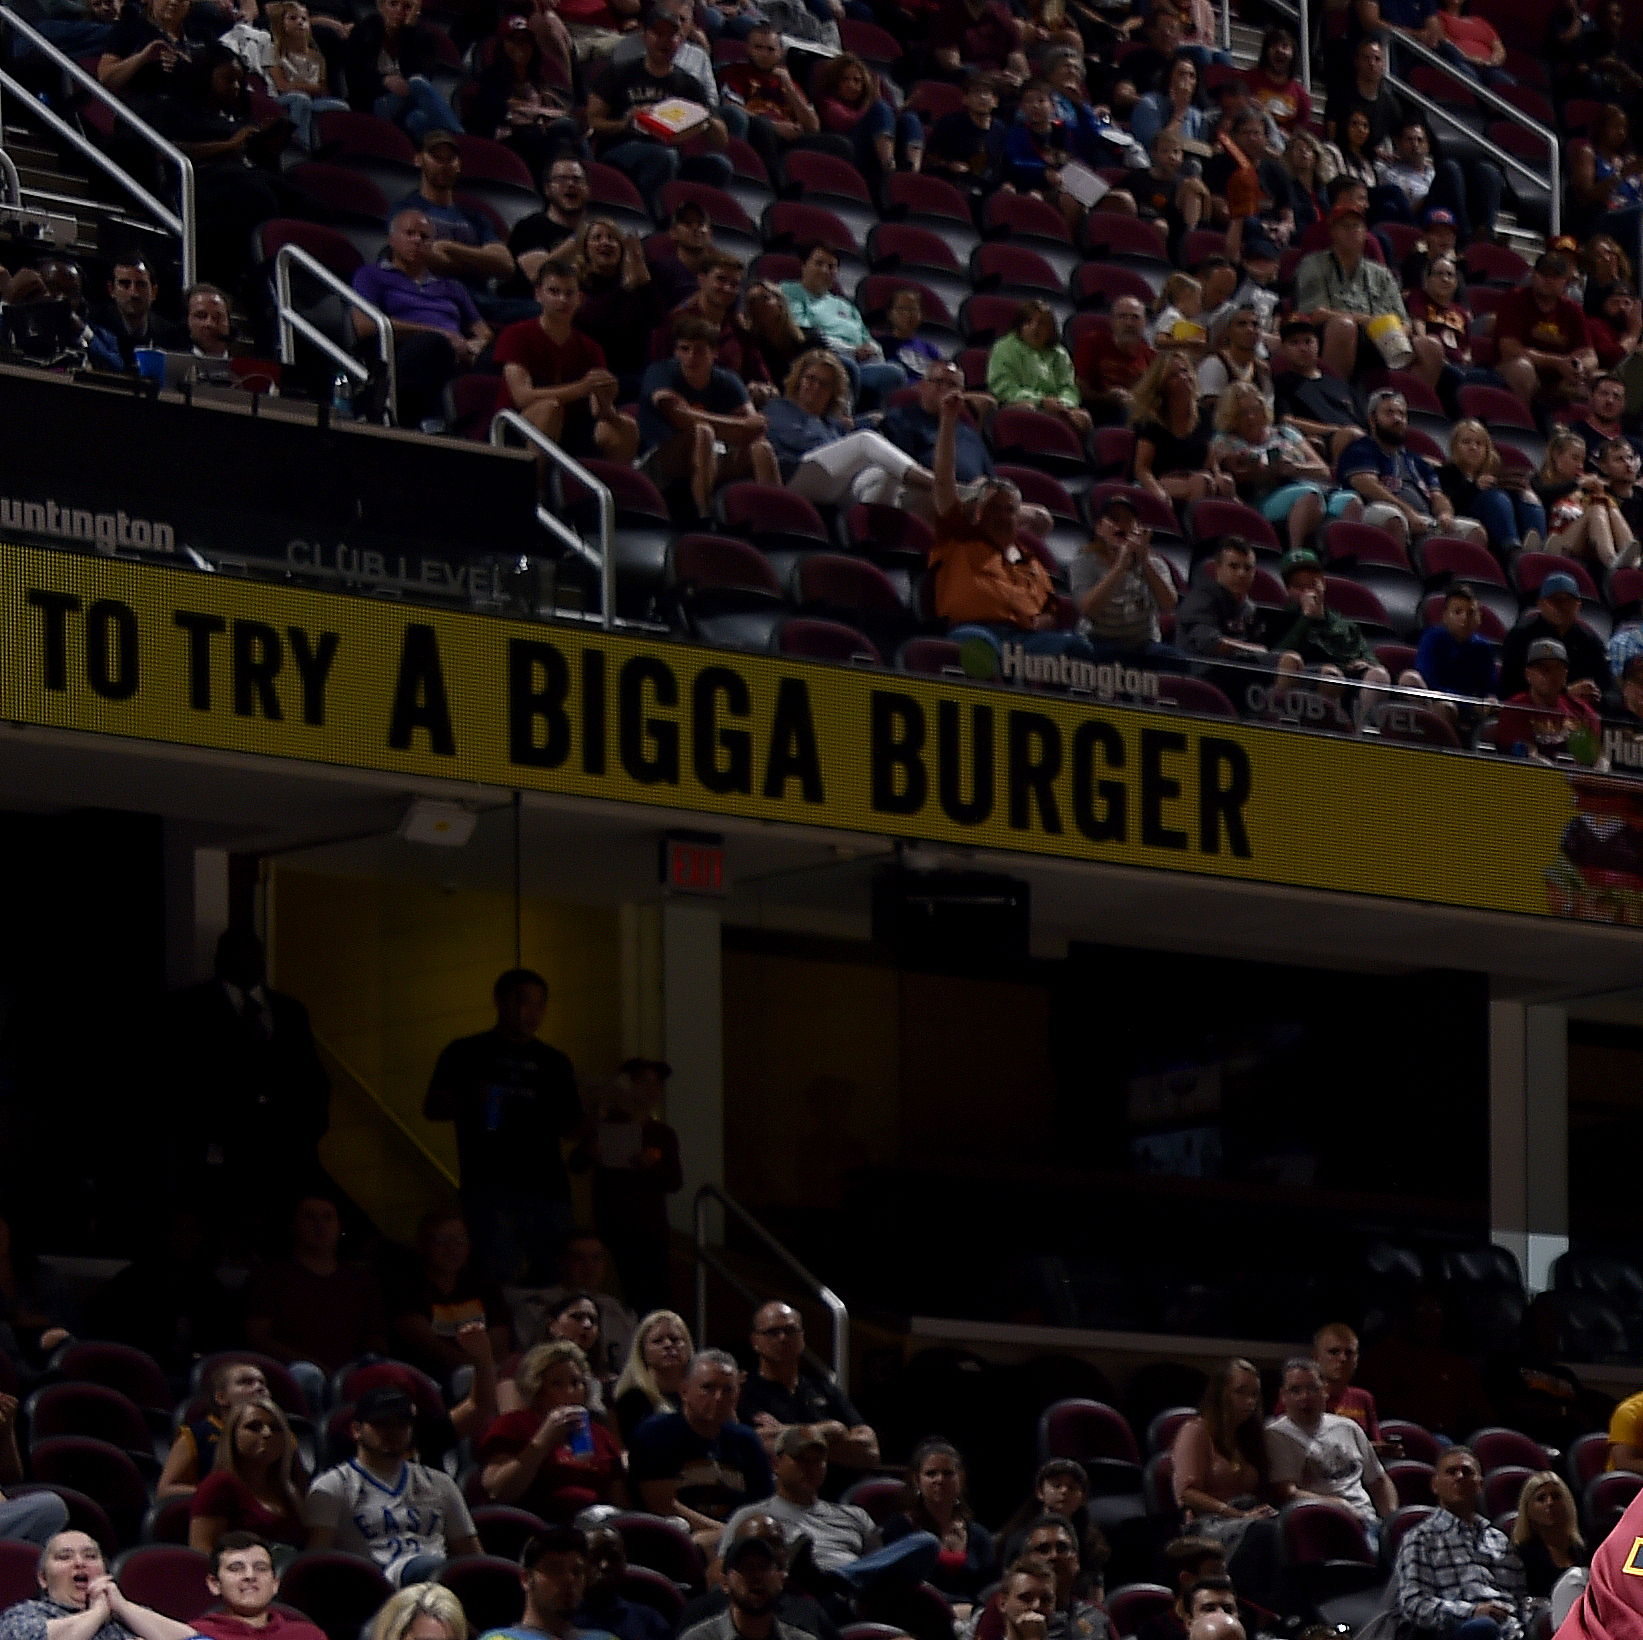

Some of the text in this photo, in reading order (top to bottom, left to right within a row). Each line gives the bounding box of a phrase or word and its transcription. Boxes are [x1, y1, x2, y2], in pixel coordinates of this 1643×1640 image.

[0, 497, 175, 557] untington
[1001, 642, 1160, 699] Huntington
[26, 588, 1254, 858] TO TRY A BIGGA BURGER
[673, 847, 722, 888] EXIT
